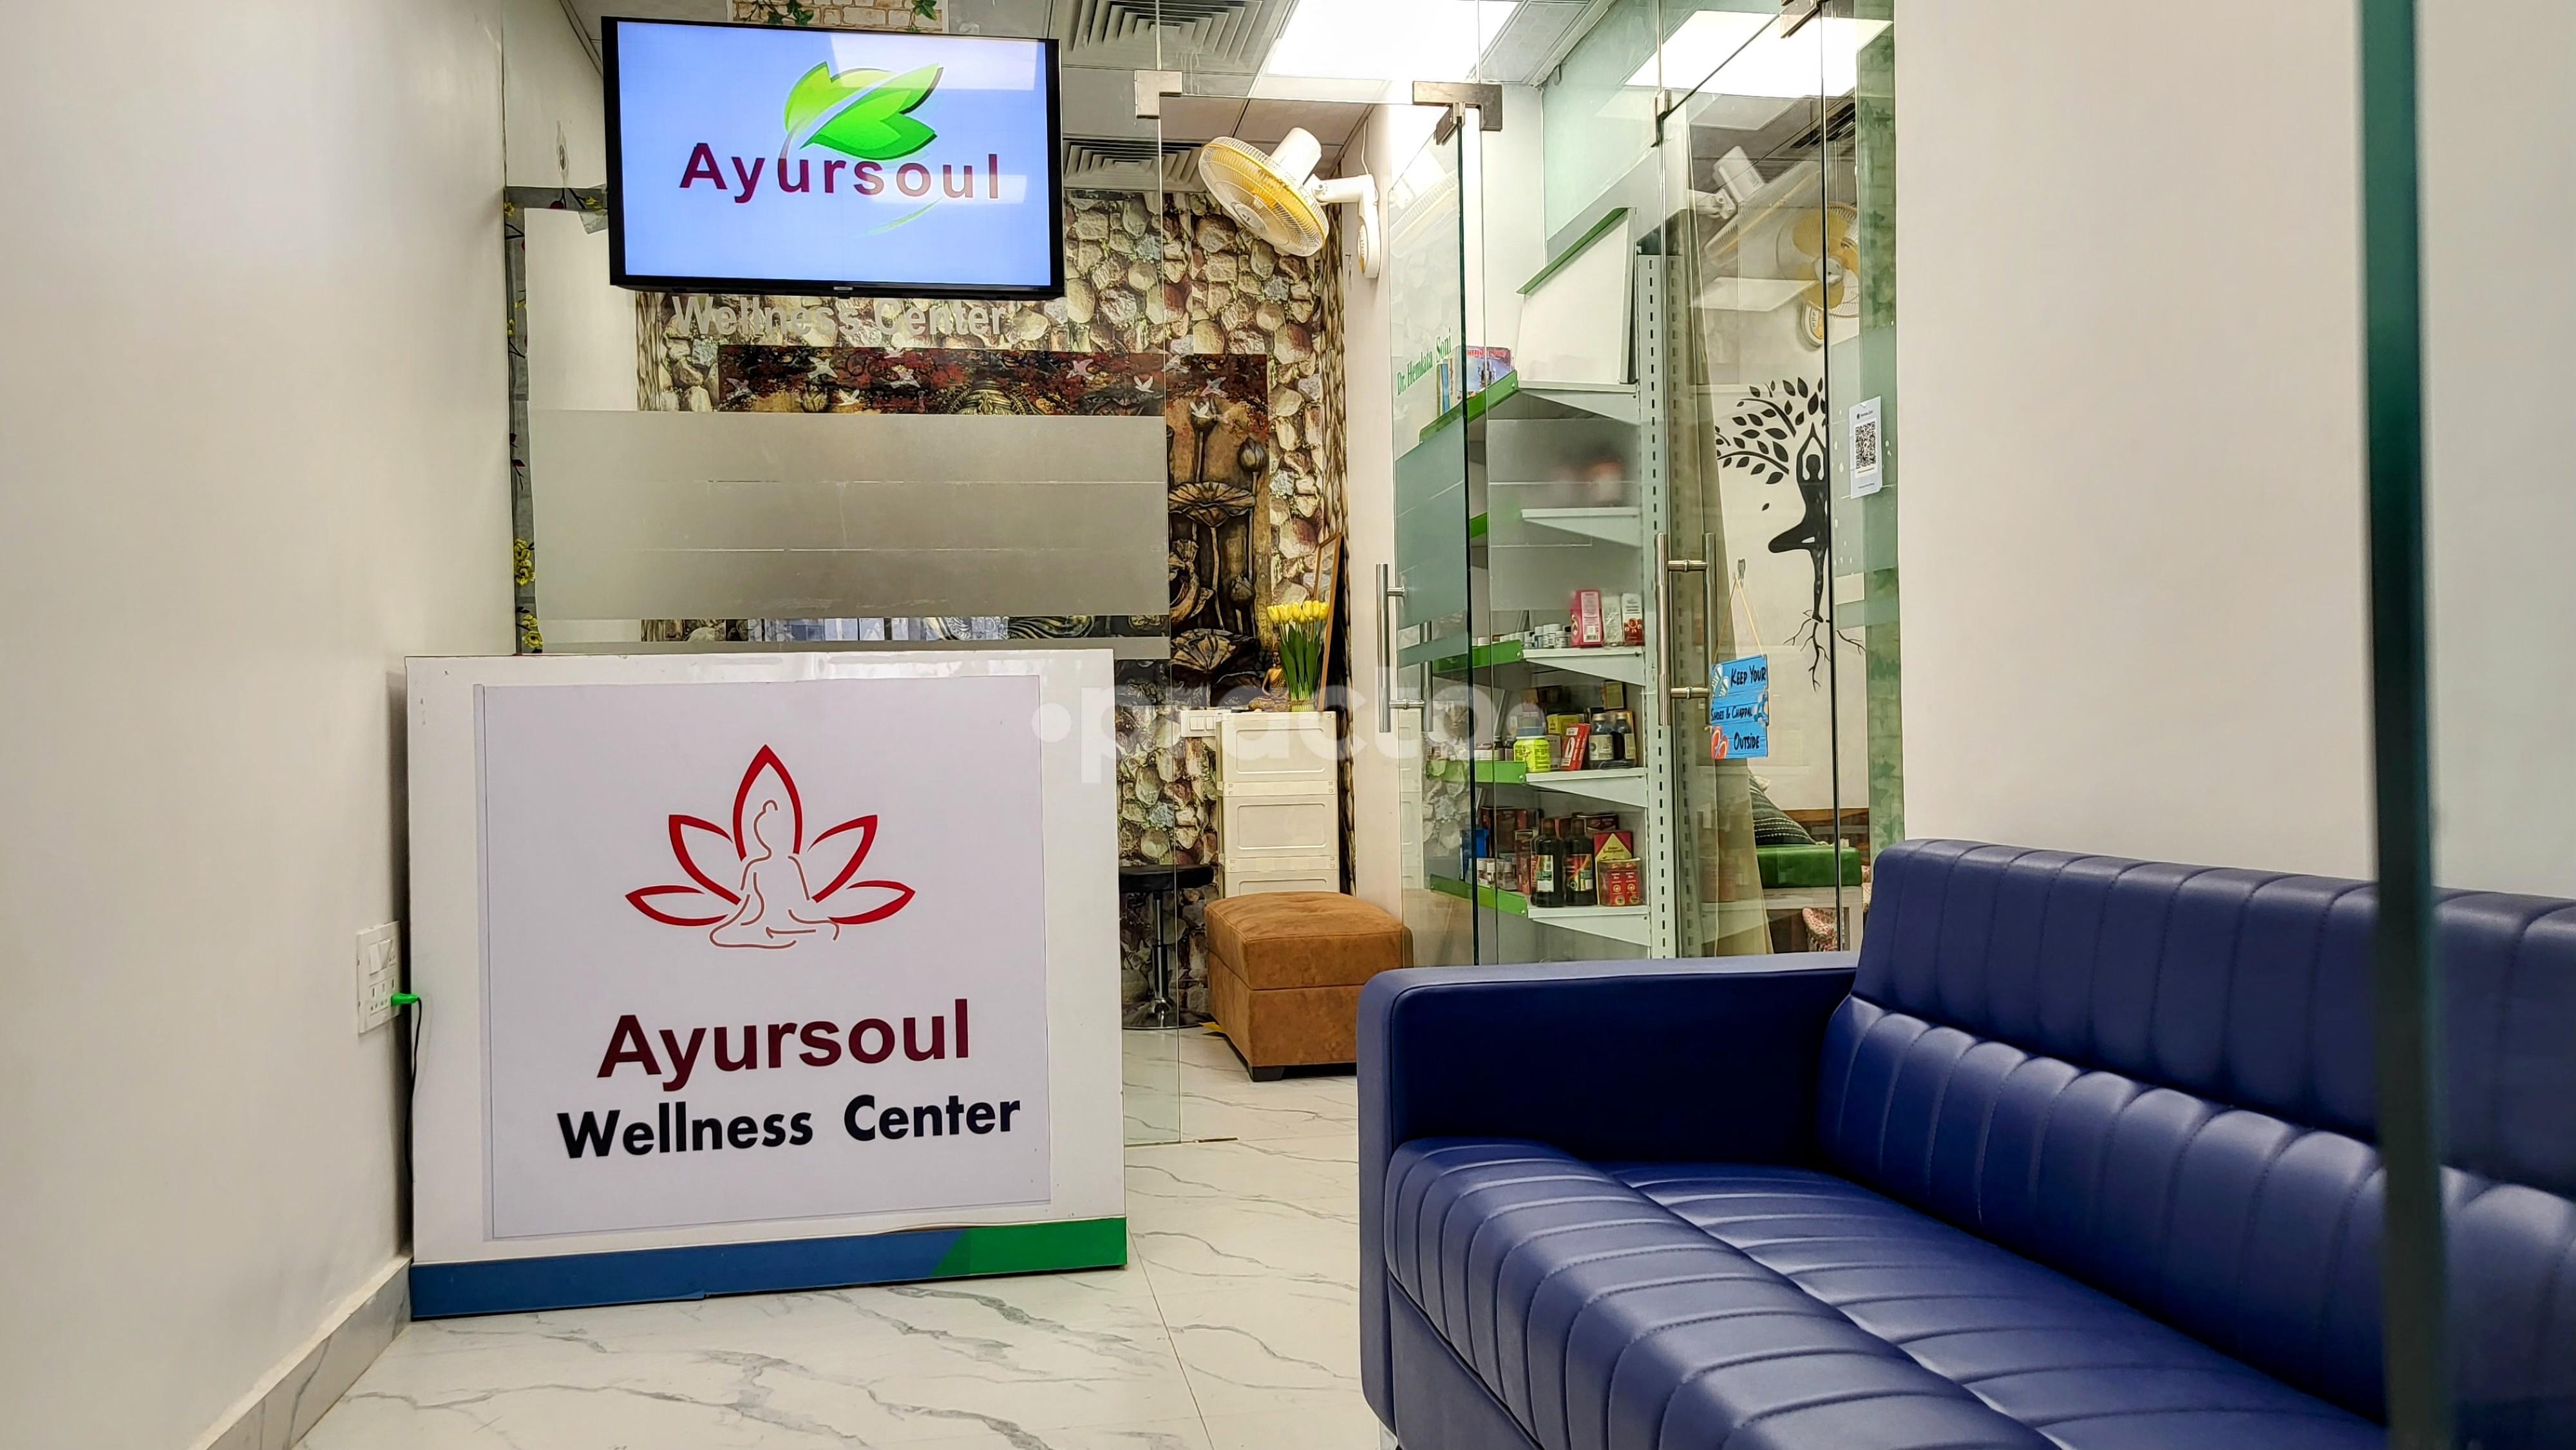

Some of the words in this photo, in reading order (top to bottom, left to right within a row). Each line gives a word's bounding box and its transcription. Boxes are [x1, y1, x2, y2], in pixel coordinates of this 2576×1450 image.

[679, 142, 999, 203] Ayursoul
[672, 296, 858, 336] Wellness
[875, 298, 1007, 335] Center
[1396, 371, 1406, 397] Dr.
[1406, 349, 1434, 388] Hemlata
[1435, 326, 1452, 363] Soni
[596, 998, 969, 1092] Ayursoul
[557, 1101, 814, 1159] Wellness
[844, 1094, 1021, 1142] Center
